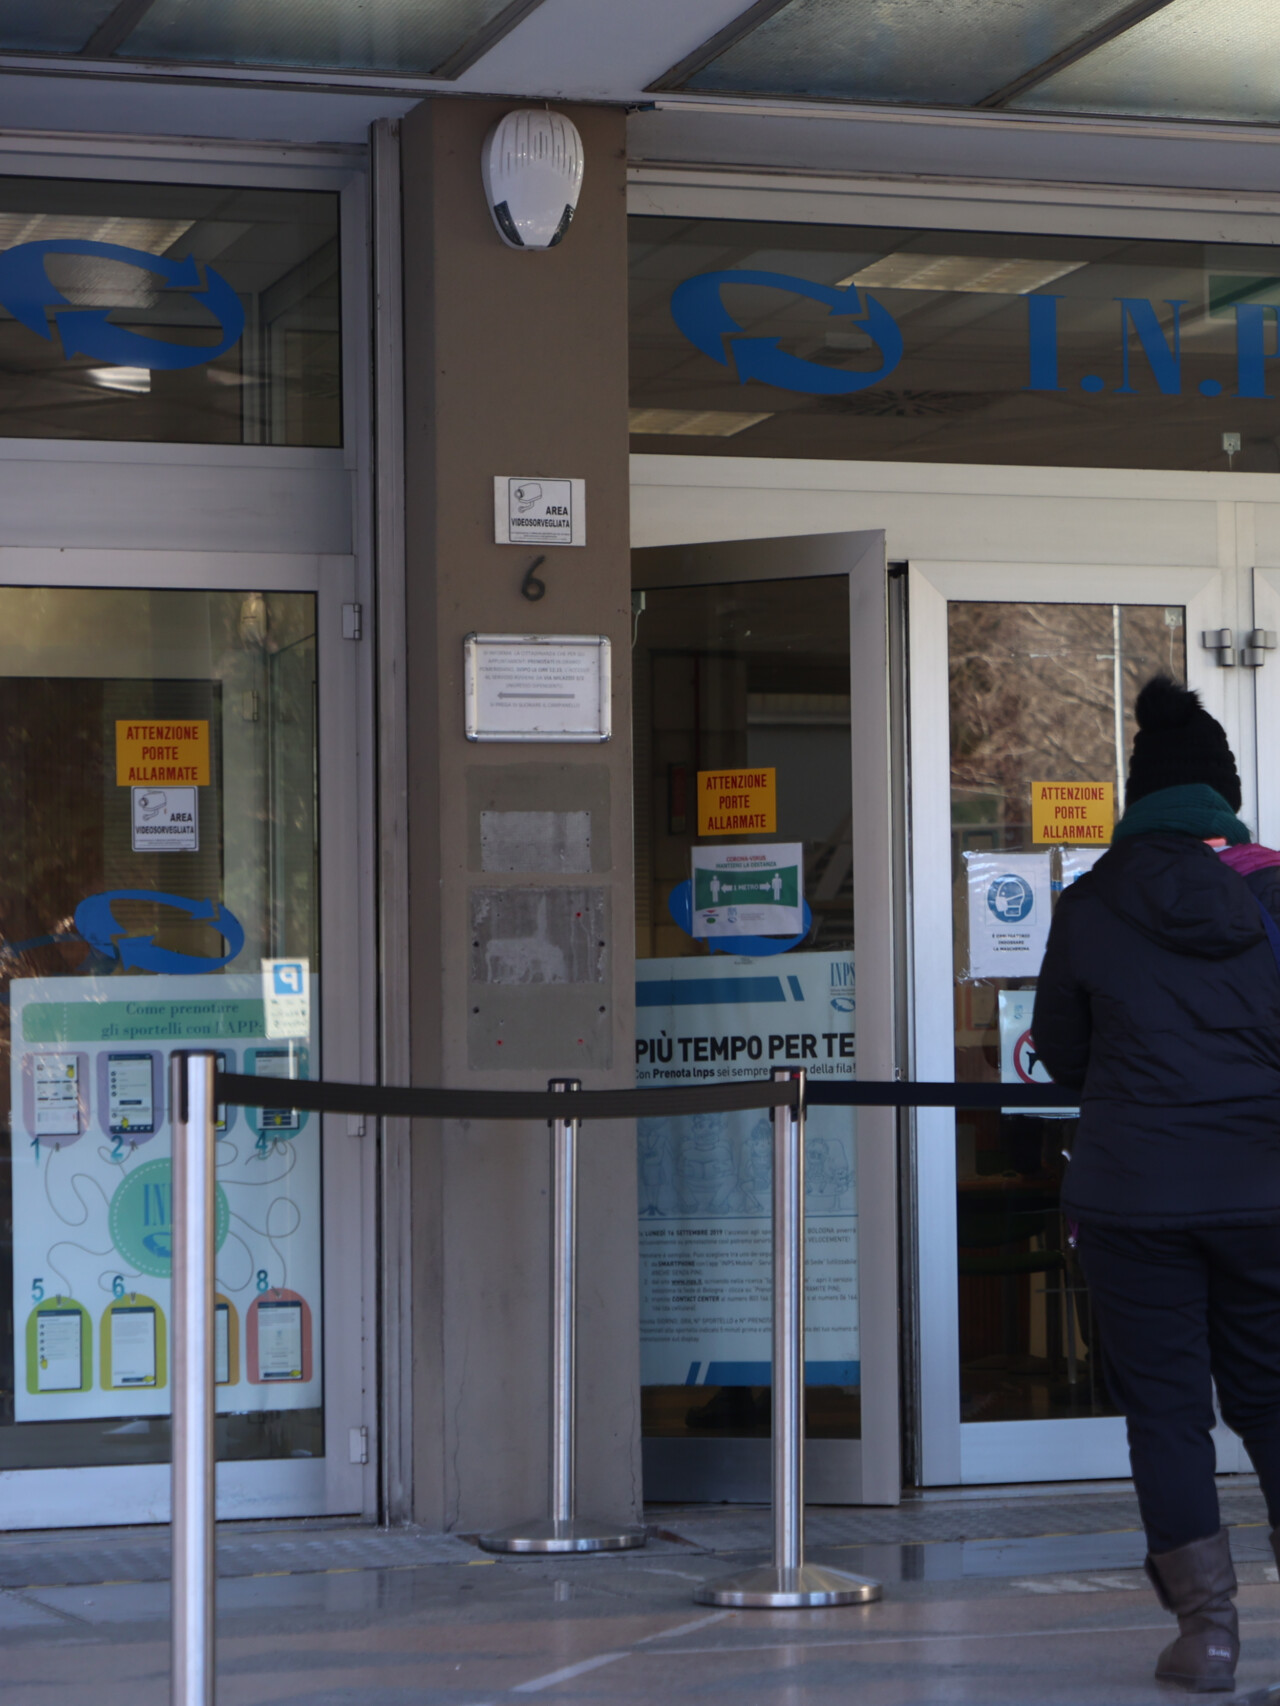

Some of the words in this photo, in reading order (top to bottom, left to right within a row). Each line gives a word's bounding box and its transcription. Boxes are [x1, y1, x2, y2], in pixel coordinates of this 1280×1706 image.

[546, 506, 568, 515] AREA
[512, 518, 570, 528] VIDEOSORVEGLIATA
[521, 555, 545, 601] 6
[127, 726, 199, 740] ATTENZIONE
[142, 746, 178, 760] PORTE
[129, 767, 198, 781] ALLARMATE
[706, 774, 767, 790] ATTENZIONE
[1041, 787, 1104, 800] ATTENZIONE
[719, 795, 750, 810] PORTE
[170, 813, 192, 822] AREA
[1055, 806, 1087, 819] PORTE
[136, 826, 195, 834] VIDEOSORVEGLIATA
[708, 814, 766, 831] ALLARMATE
[1043, 825, 1104, 839] ALLARMATE
[126, 1002, 165, 1016] Come
[170, 1003, 239, 1021] prenotare
[101, 1022, 119, 1038] gli
[123, 1021, 182, 1038] sportelli
[186, 1022, 211, 1034] con
[636, 1030, 672, 1064] PIÙ
[678, 1035, 762, 1063] TEMPO
[768, 1034, 818, 1060] PER
[822, 1033, 855, 1058] TE
[653, 1068, 691, 1079] Prenota
[717, 1067, 730, 1077] sei
[732, 1067, 769, 1079] sempre
[810, 1063, 834, 1074] della
[836, 1062, 856, 1074] fila!
[30, 1138, 39, 1163] 1
[111, 1135, 124, 1160] 2
[255, 1131, 268, 1158] 4
[112, 1276, 125, 1299] 6
[256, 1269, 268, 1292] 8
[31, 1278, 44, 1300] 5
